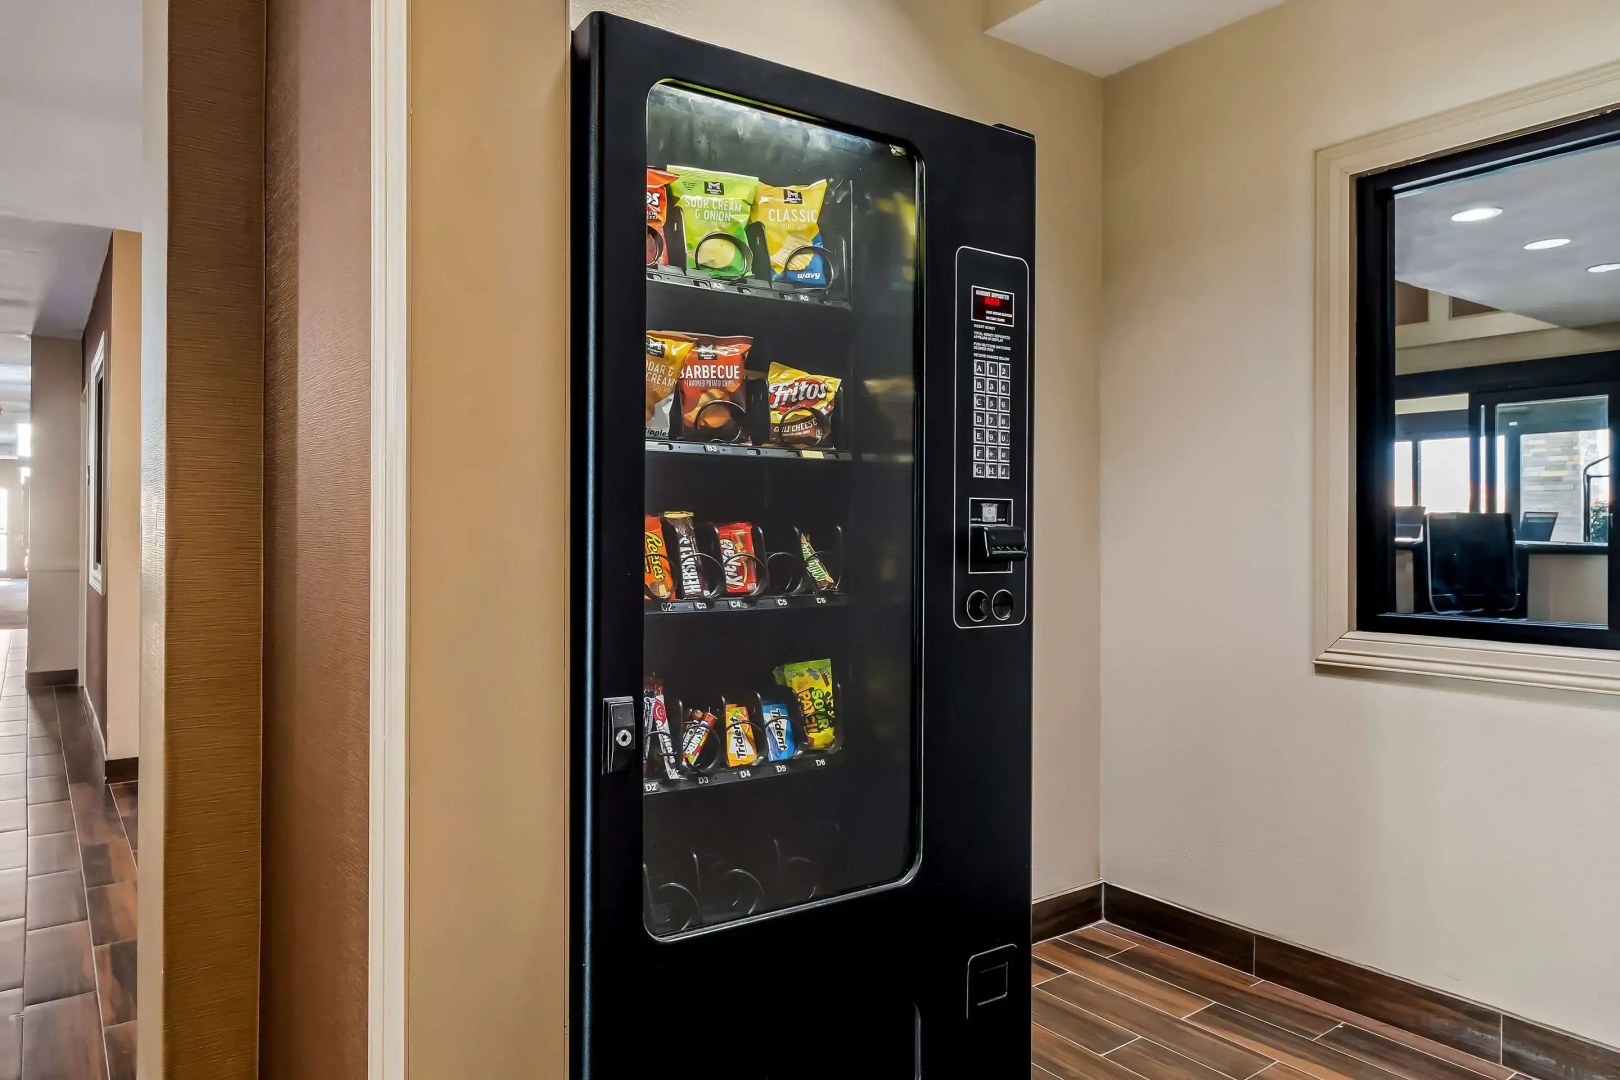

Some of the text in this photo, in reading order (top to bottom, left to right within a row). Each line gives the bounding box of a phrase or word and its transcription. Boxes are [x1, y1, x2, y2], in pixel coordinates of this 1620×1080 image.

[684, 197, 742, 212] SOUR CREAM
[695, 209, 731, 222] & ONION
[768, 208, 818, 223] CLASSIC
[713, 282, 723, 290] A3
[646, 360, 674, 376] DAR &
[646, 372, 674, 388] CREAM
[769, 381, 828, 408] Fritos
[791, 418, 818, 432] CHEESE
[645, 531, 666, 580] Reese's
[661, 602, 673, 612] C2
[798, 690, 819, 734] PATCH
[812, 688, 830, 730] SOUR
[656, 720, 676, 764] AIHEAS
[730, 716, 746, 760] Trident
[740, 770, 751, 778] D4
[646, 784, 657, 792] D2
